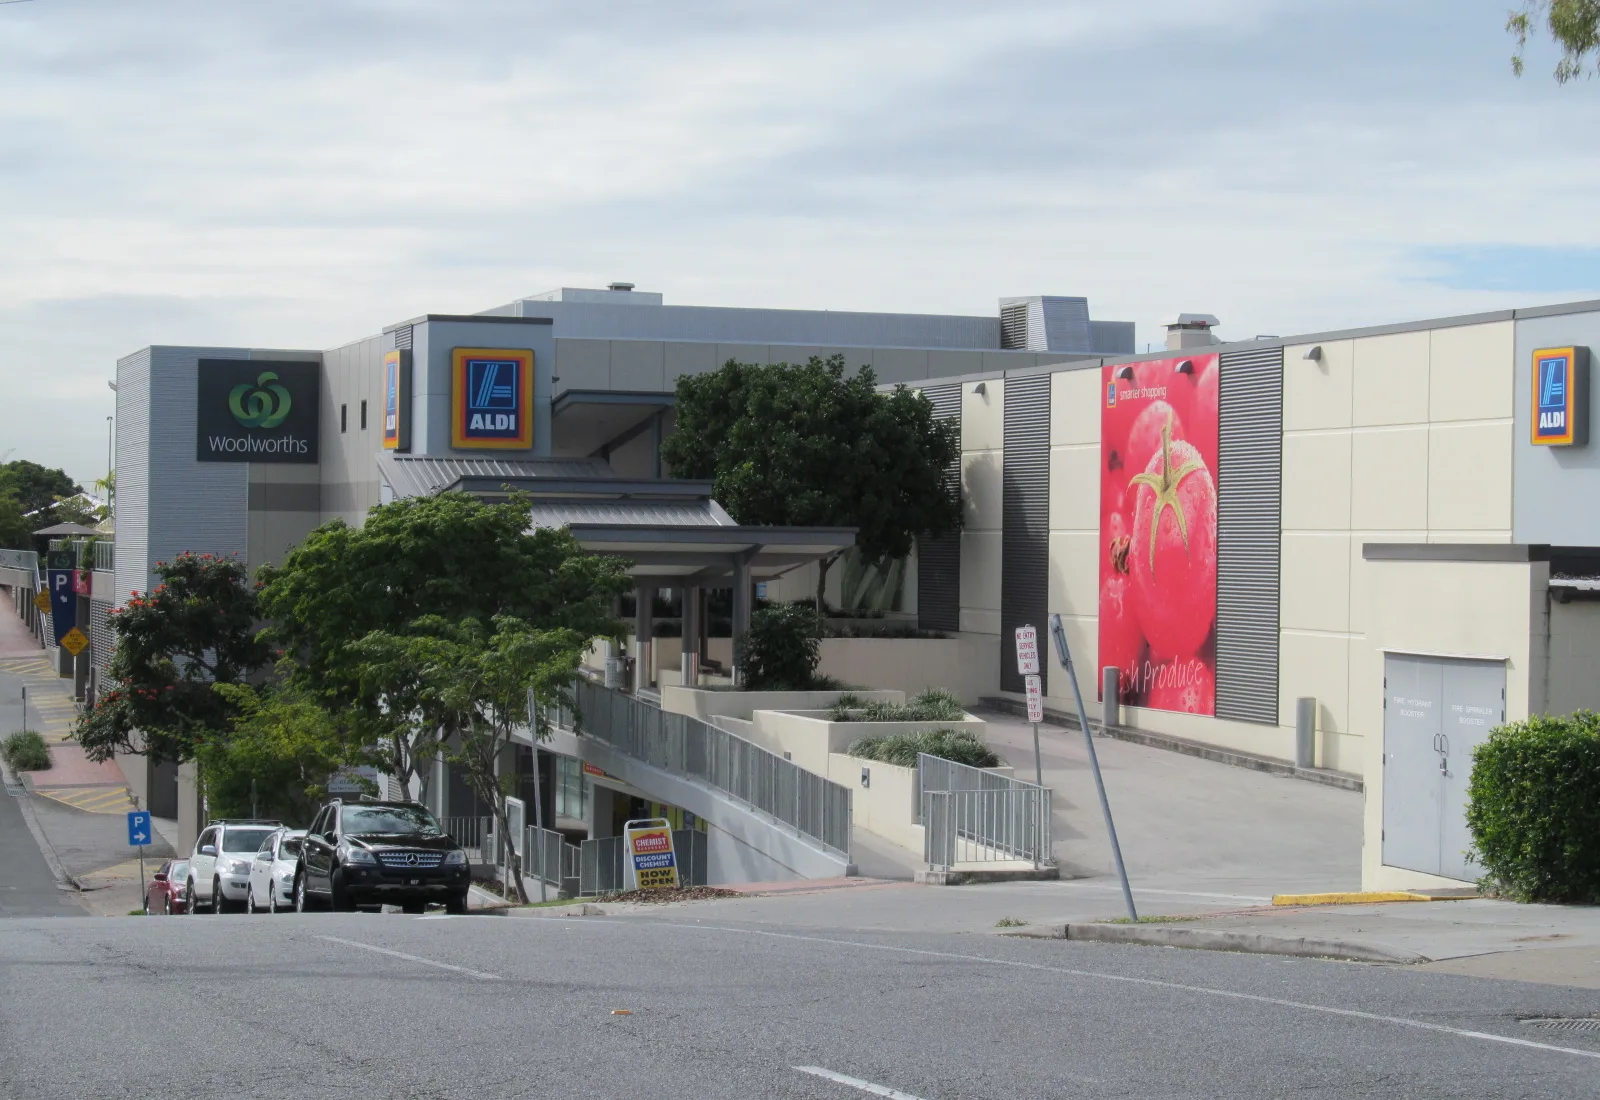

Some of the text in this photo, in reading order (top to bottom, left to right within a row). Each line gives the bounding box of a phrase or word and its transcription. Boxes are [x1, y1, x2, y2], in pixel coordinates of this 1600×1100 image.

[1141, 384, 1166, 400] shopping
[470, 413, 515, 430] ALDI
[1540, 412, 1564, 428] ALDI
[209, 434, 308, 453] Woolworths
[56, 574, 67, 591] P
[1019, 642, 1034, 650] SERVICE
[1019, 652, 1036, 660] VEHICLES
[1143, 655, 1203, 693] Produce
[1394, 697, 1432, 708] FIRE HYDRANT
[1400, 709, 1425, 718] BOOSTER
[1452, 705, 1493, 715] FIRE SPRINKLER
[1459, 716, 1484, 726] BOOSTER
[134, 816, 144, 828] P
[636, 837, 666, 846] CHEMIST
[636, 854, 671, 862] DISCOUNT
[641, 870, 671, 878] NOW
[641, 878, 674, 886] OPEN
